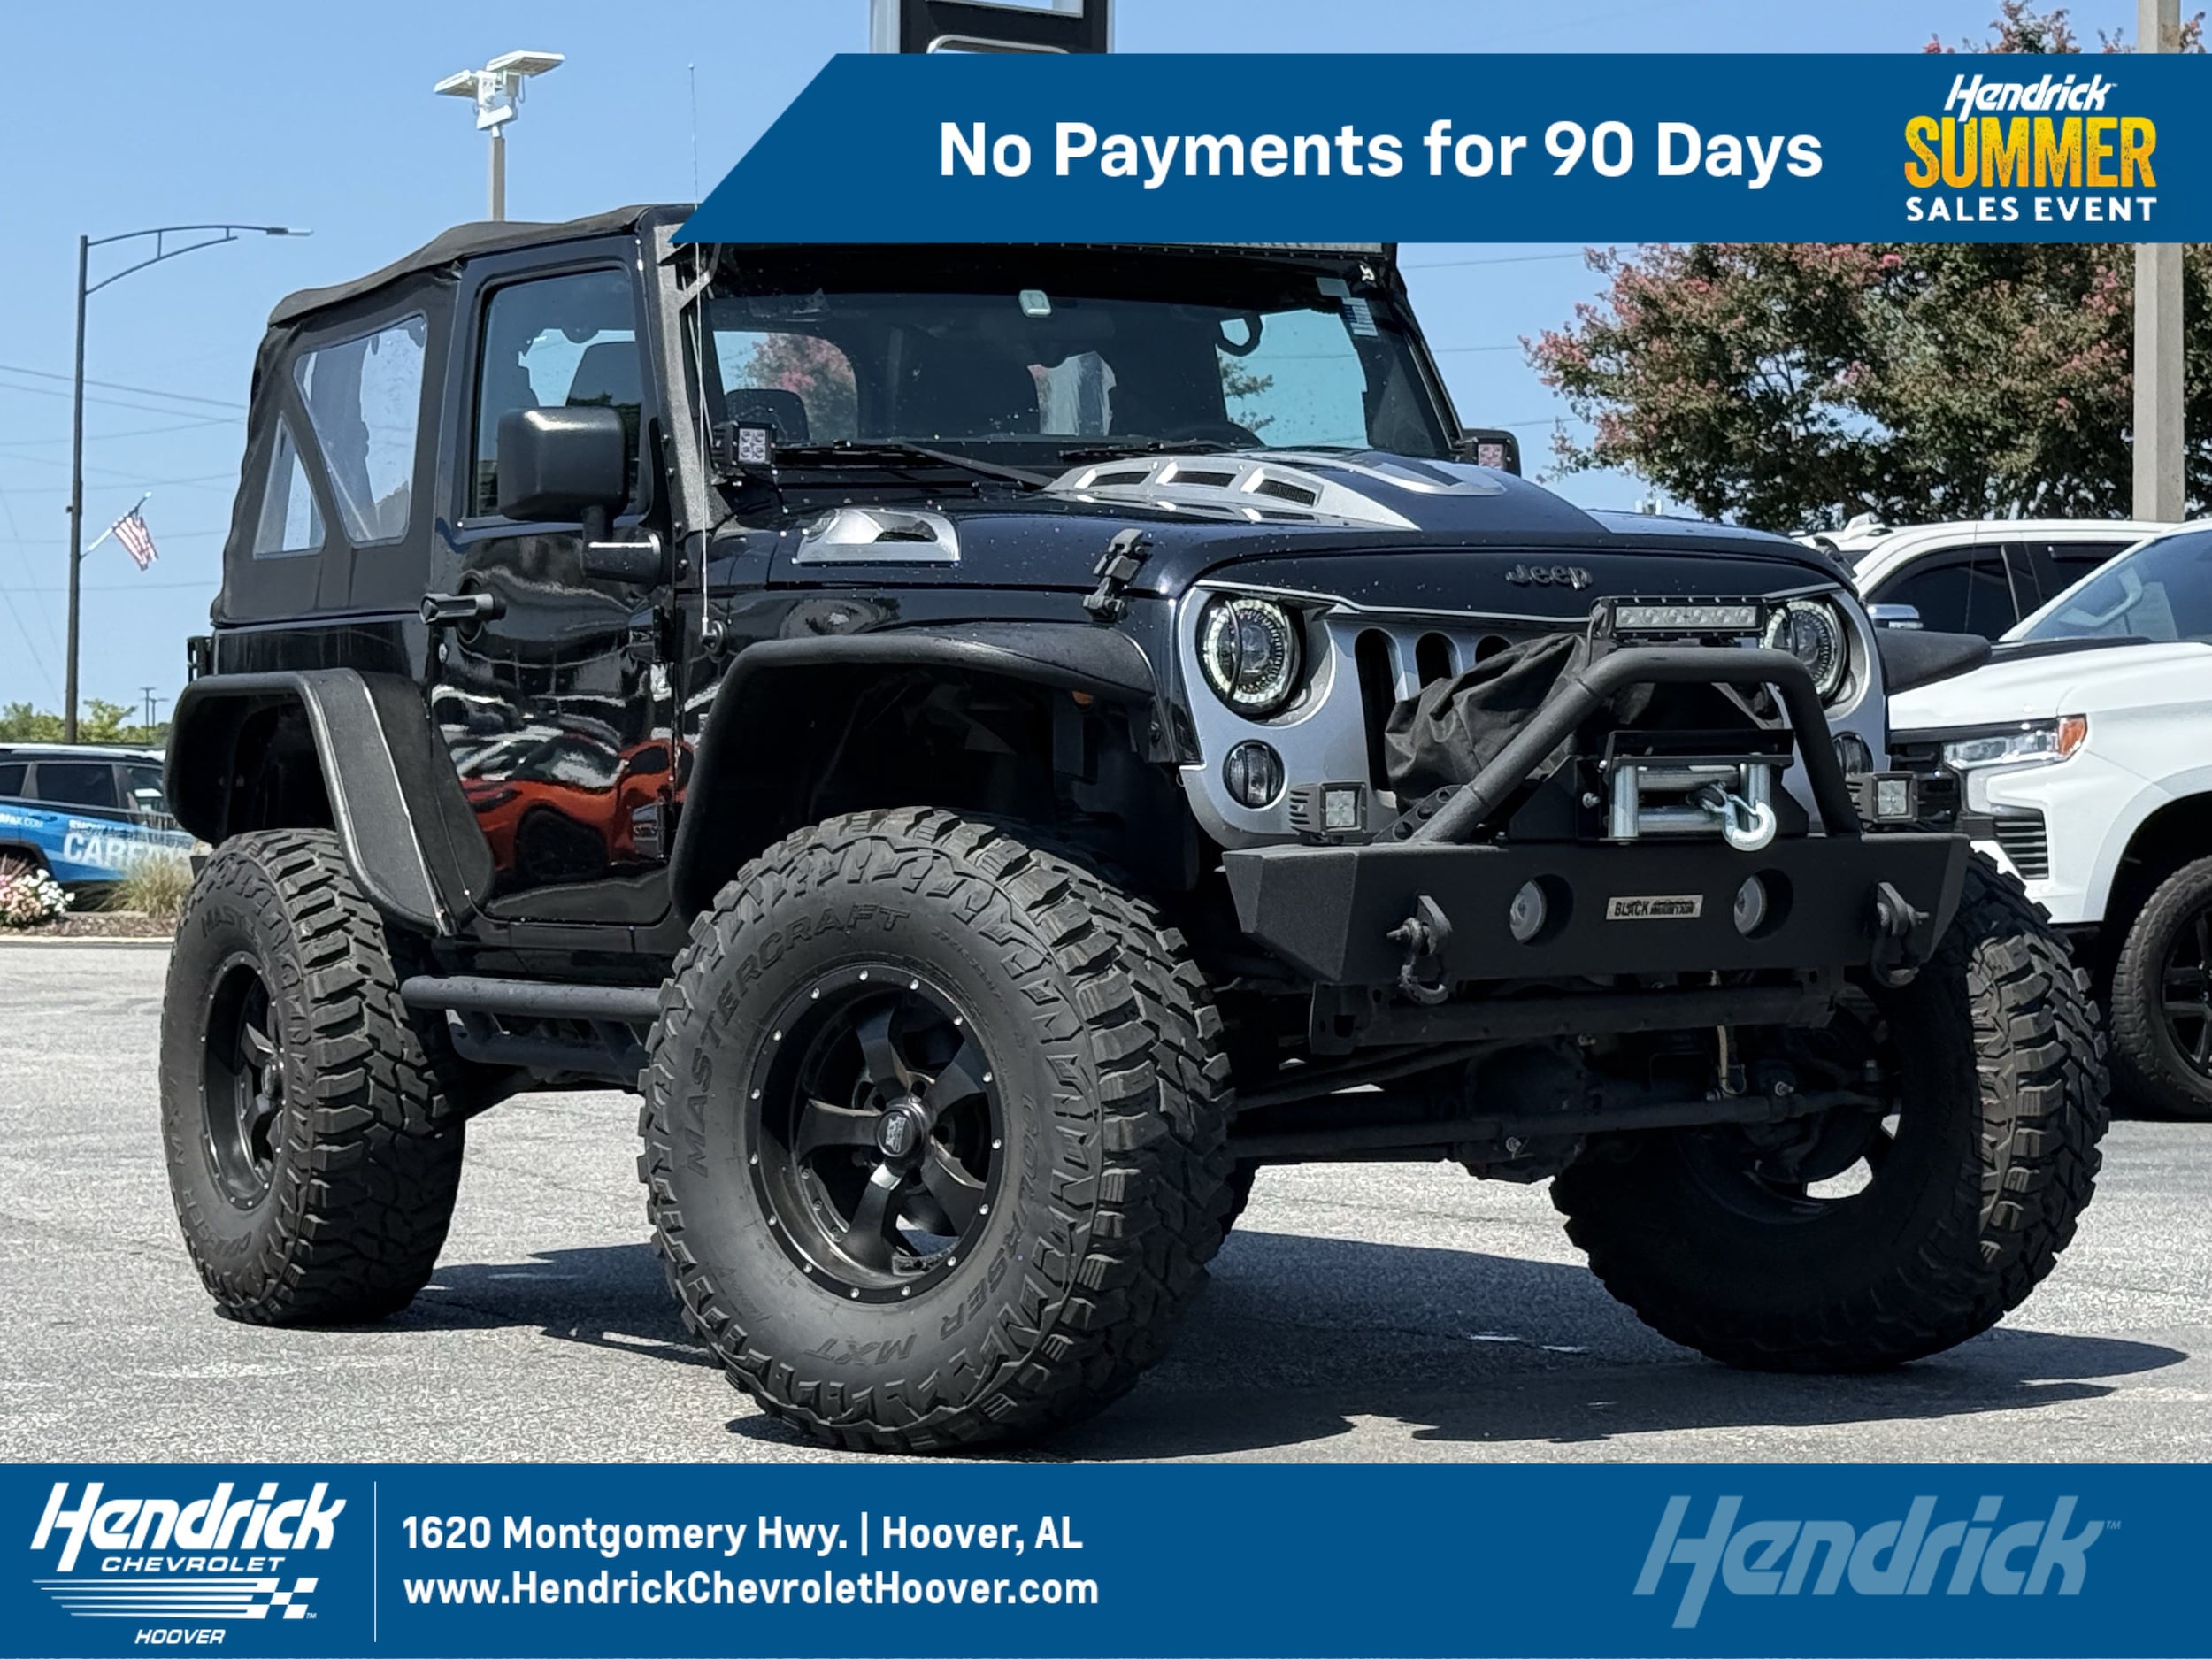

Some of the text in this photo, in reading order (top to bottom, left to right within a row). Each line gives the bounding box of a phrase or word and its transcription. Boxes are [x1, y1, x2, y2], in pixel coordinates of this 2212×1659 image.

[1504, 564, 1593, 590] Jeep
[1614, 899, 1649, 917] BLACK
[676, 903, 910, 1179] MASTERCRAFT
[802, 1330, 918, 1367] MXT
